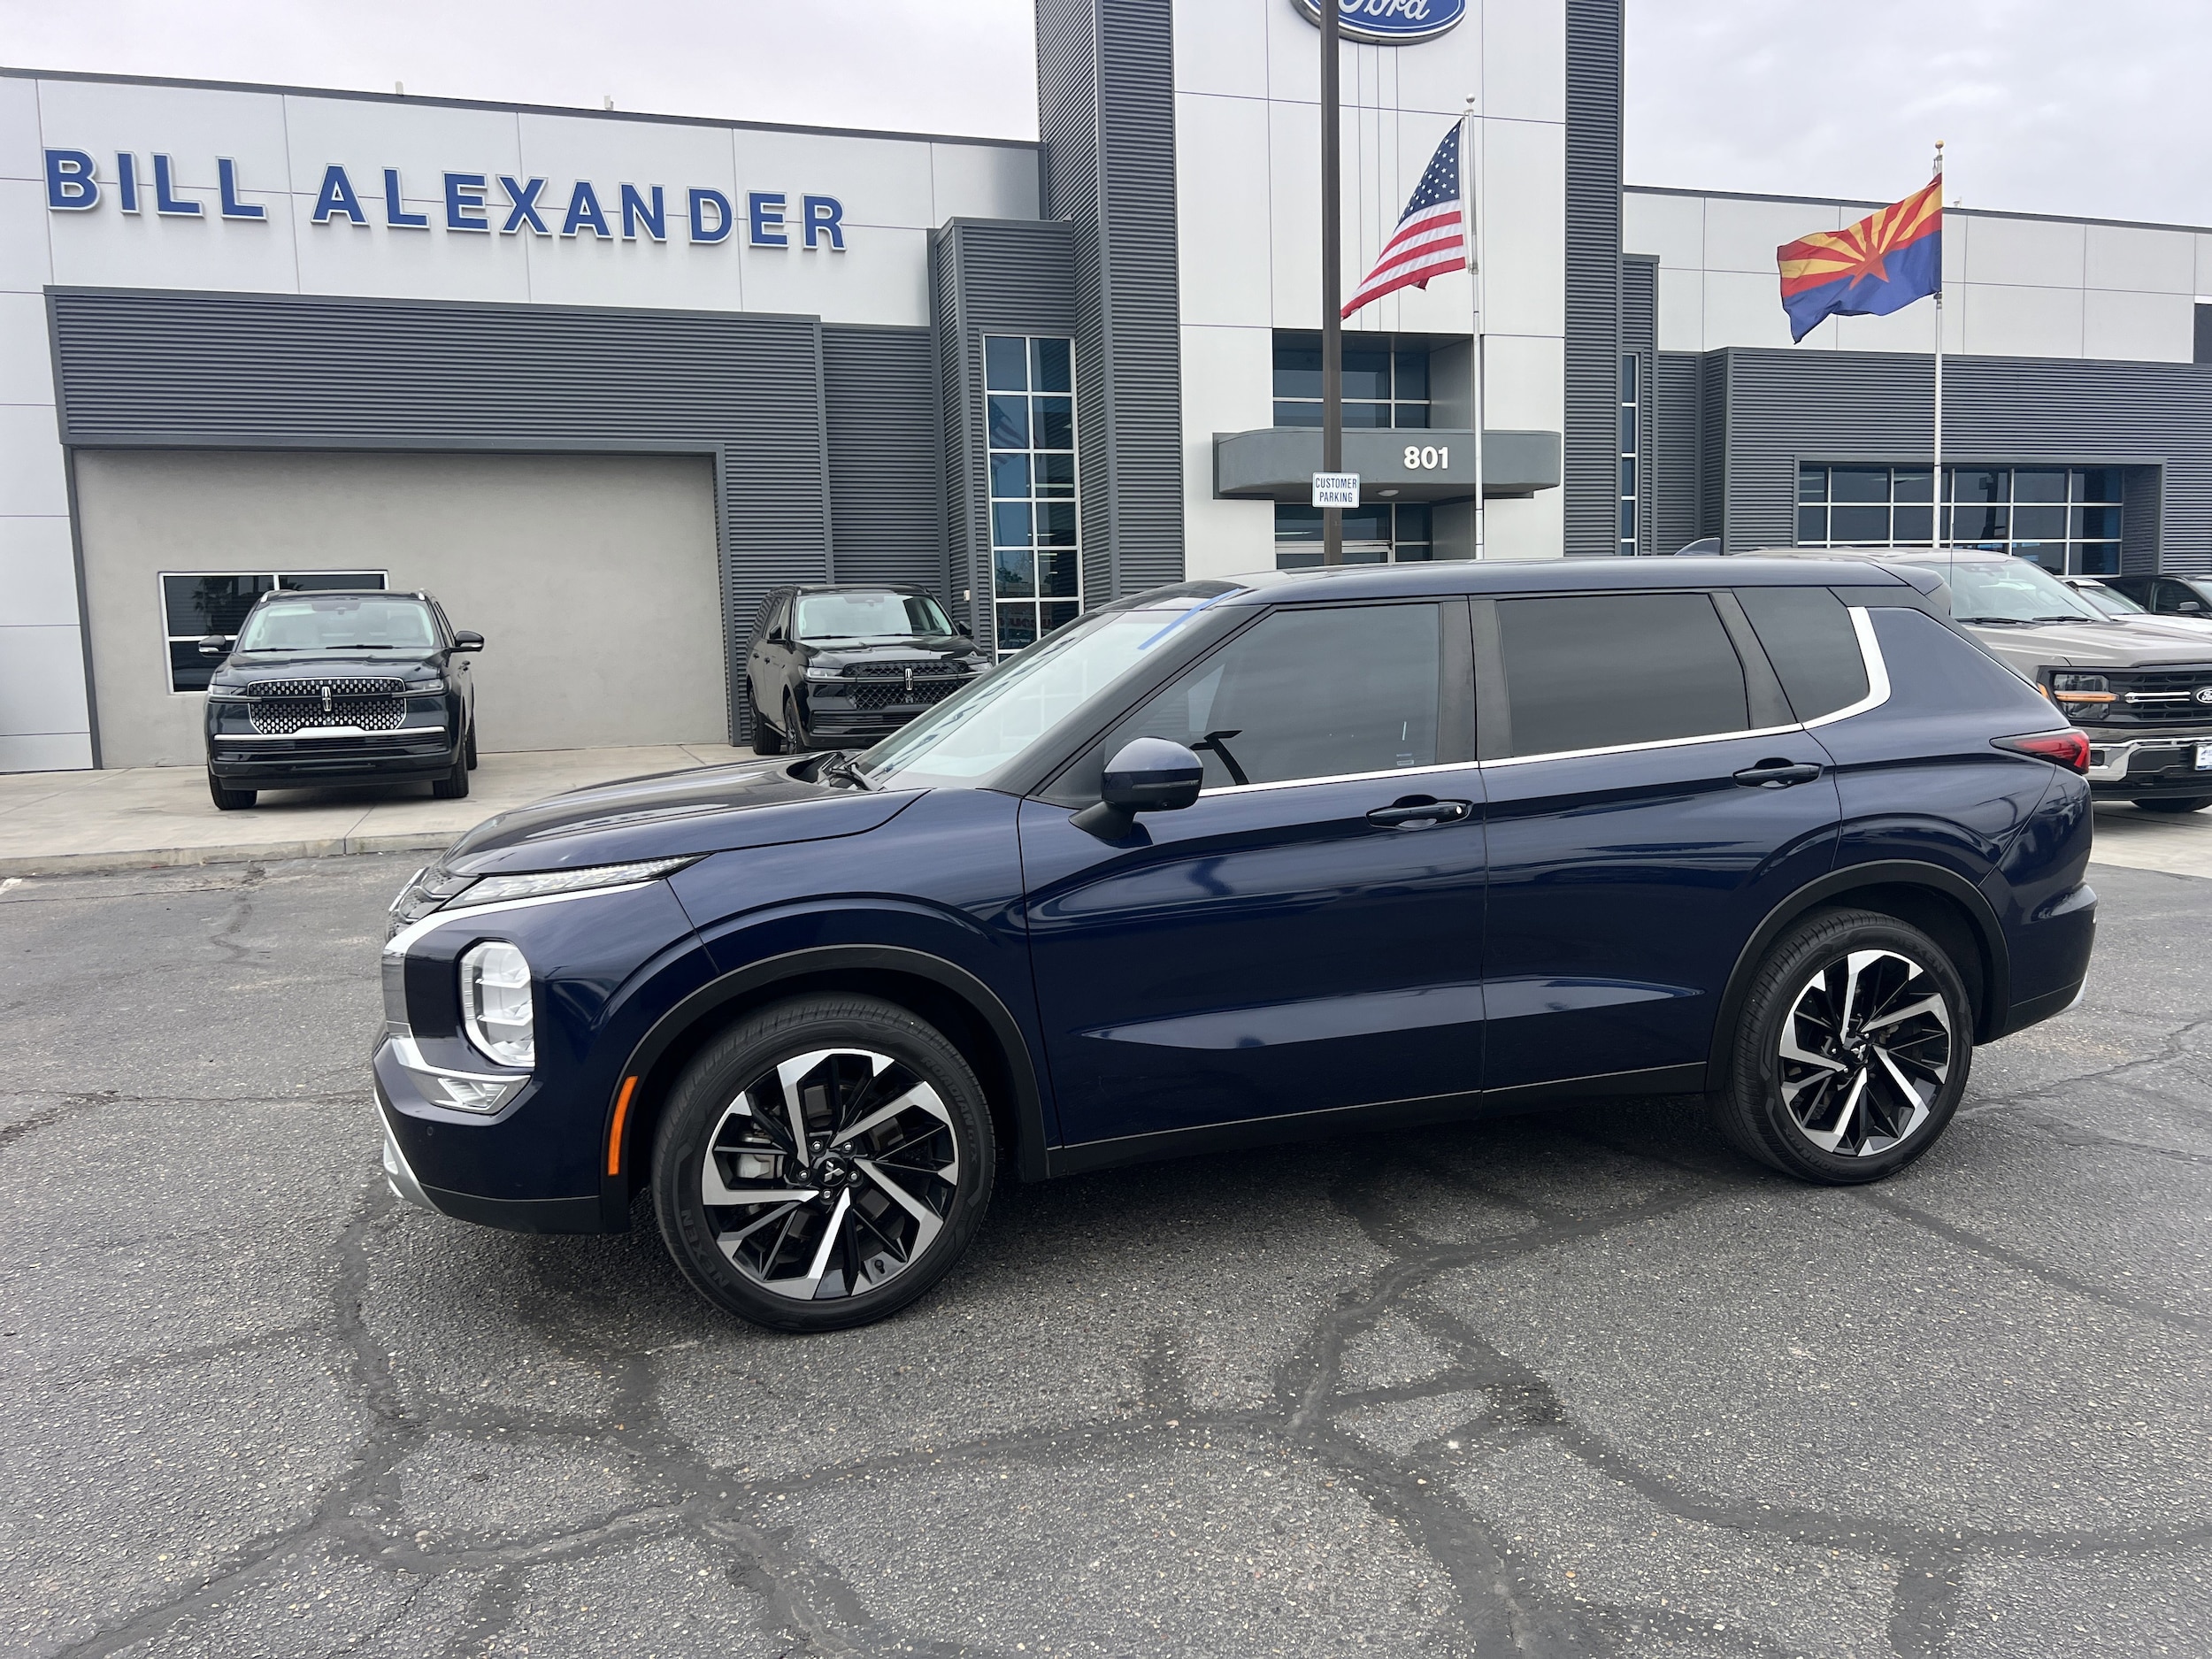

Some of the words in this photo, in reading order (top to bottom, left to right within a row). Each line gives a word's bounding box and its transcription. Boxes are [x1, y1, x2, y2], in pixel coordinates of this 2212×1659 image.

[44, 147, 267, 220] BILL
[310, 163, 847, 252] ALEXANDER
[1403, 445, 1448, 470] 801
[1315, 477, 1357, 488] CUSTOMER
[1319, 492, 1353, 503] PARKING
[921, 1056, 974, 1125] ROADIAN
[680, 1209, 730, 1288] NEXEN
